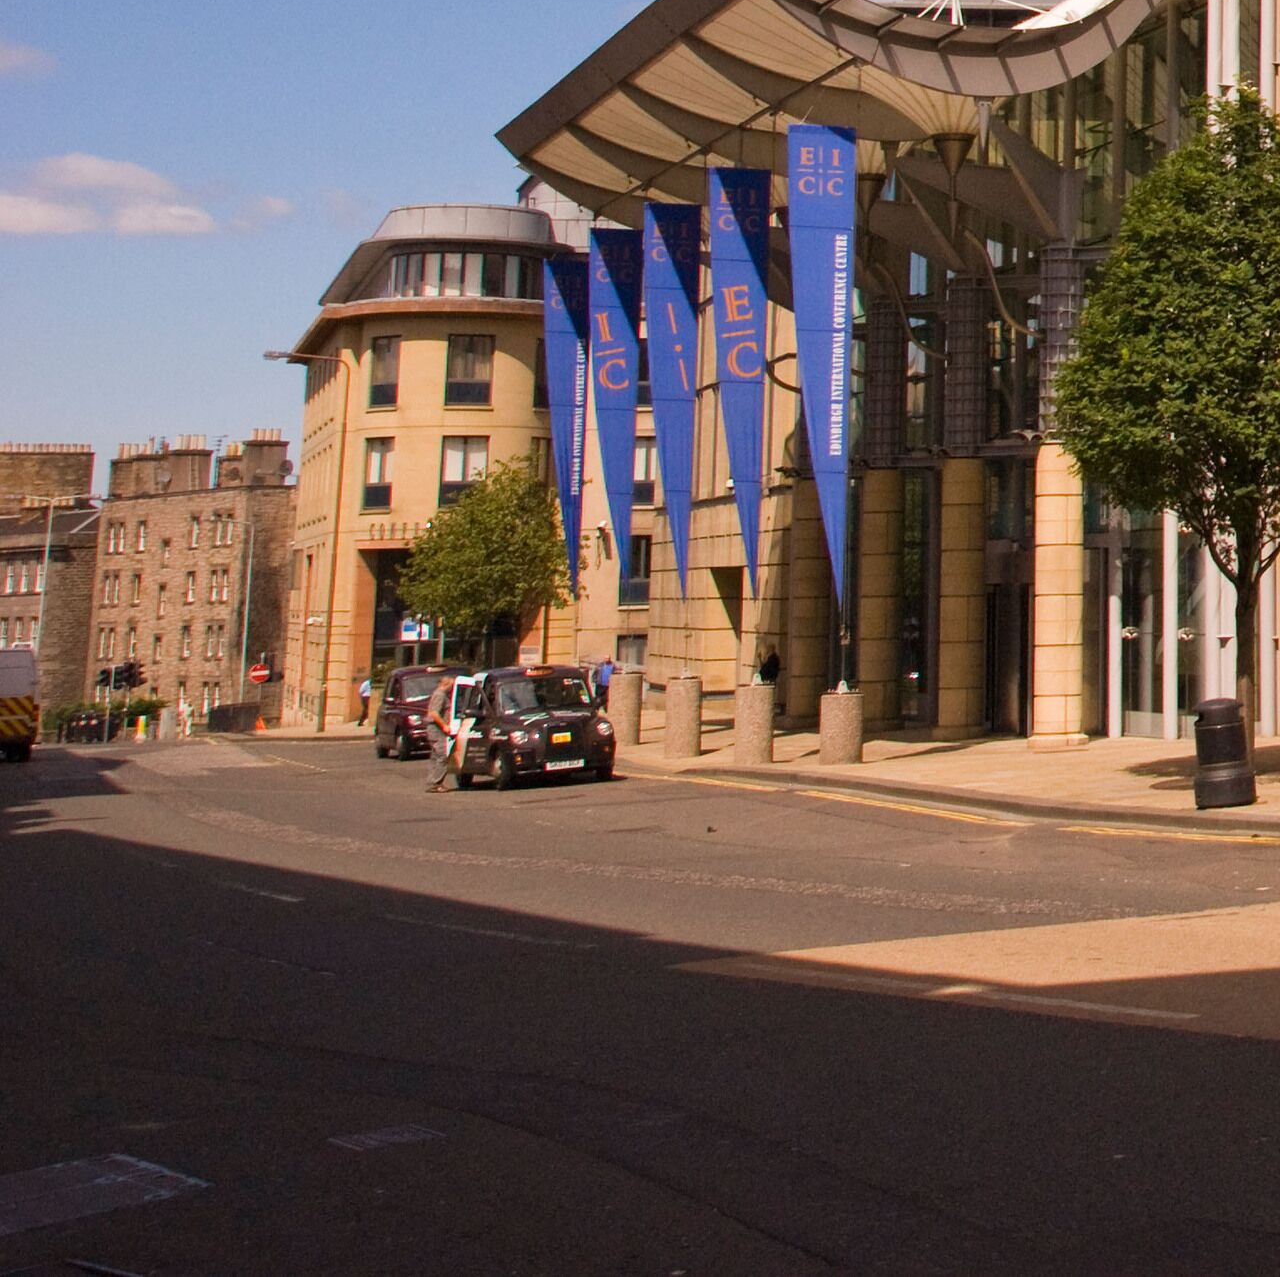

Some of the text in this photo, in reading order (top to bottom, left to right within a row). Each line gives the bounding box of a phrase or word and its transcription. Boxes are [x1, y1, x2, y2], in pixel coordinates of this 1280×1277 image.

[800, 147, 815, 165] E
[798, 175, 844, 196] C C
[721, 285, 754, 323] E
[595, 312, 614, 342] I
[726, 341, 762, 379] C
[829, 234, 848, 456] EDINBURGH INTERNATIONAL CONFERENCE CENTRE
[598, 358, 630, 390] C
